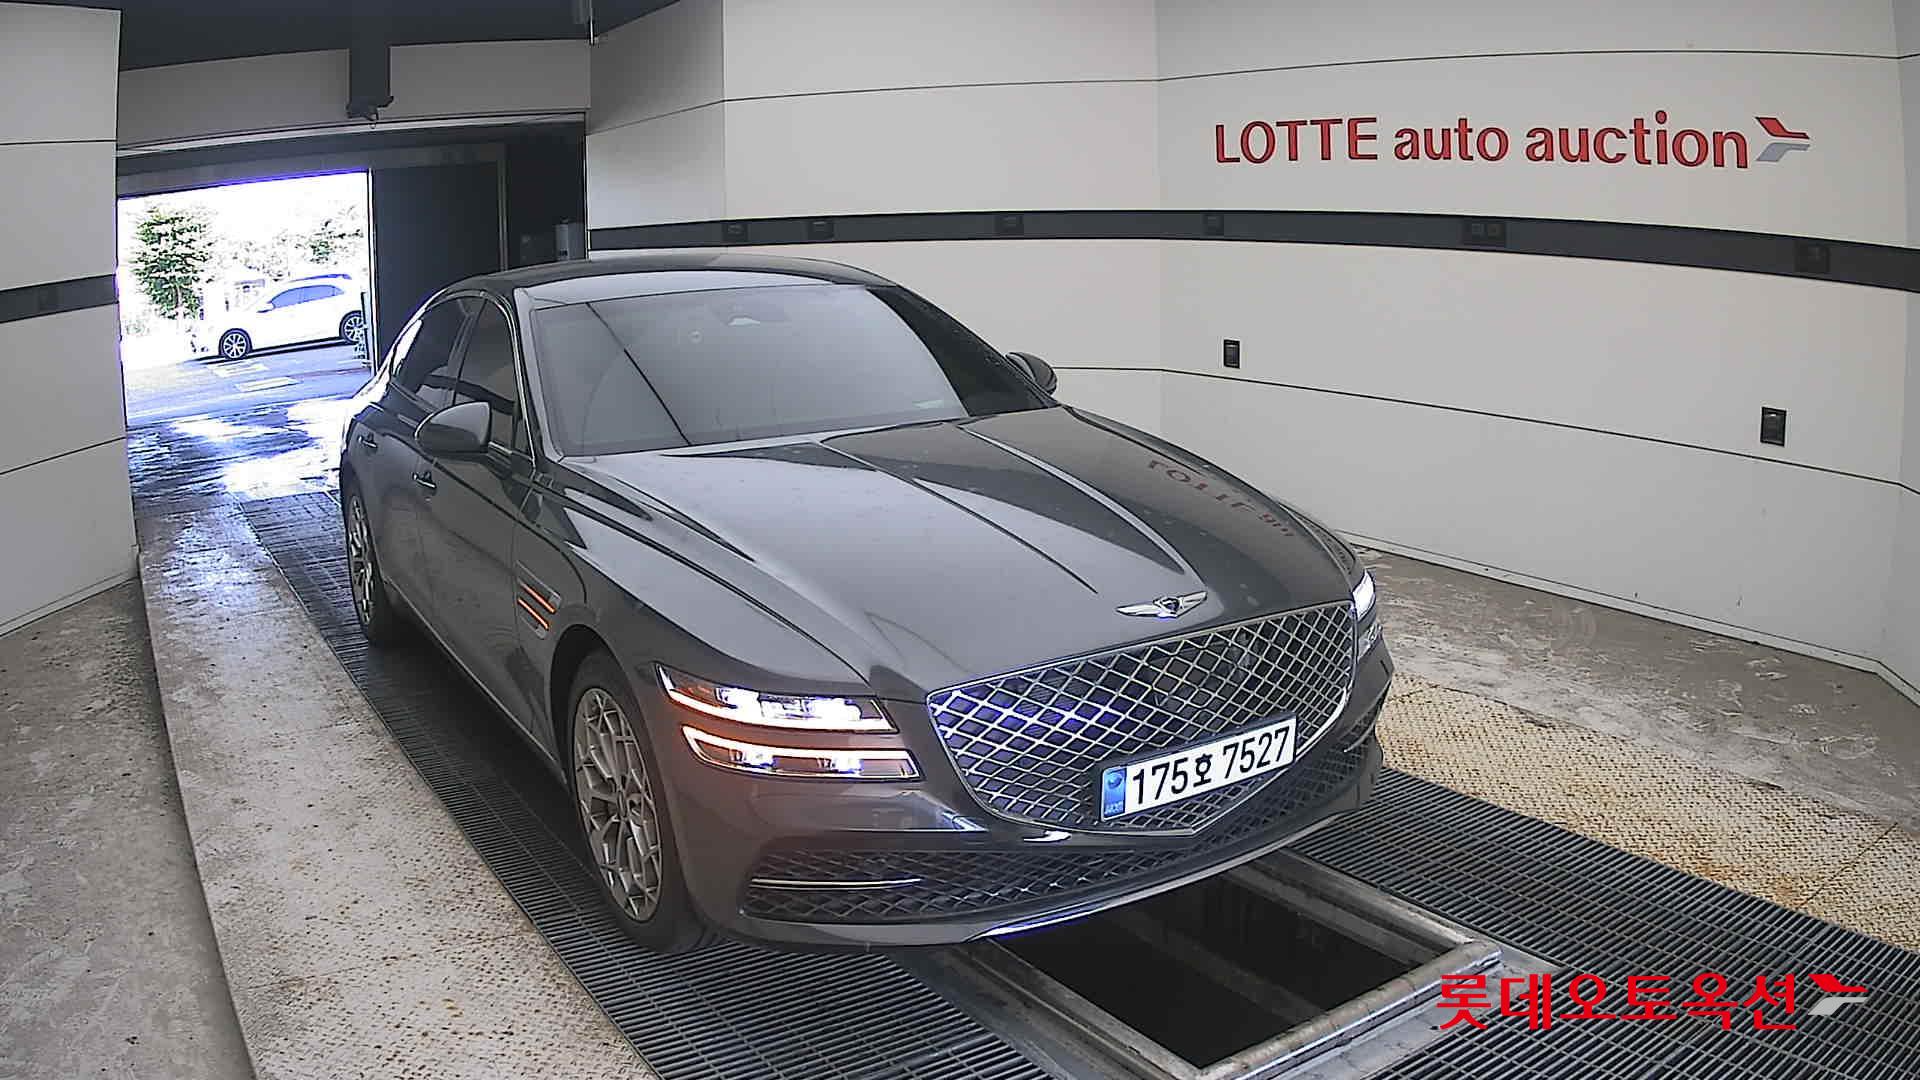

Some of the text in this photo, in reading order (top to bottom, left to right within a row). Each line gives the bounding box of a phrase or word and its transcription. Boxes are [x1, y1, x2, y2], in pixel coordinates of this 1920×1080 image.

[1215, 110, 1749, 169] LOTTE auto auction
[1132, 726, 1290, 805] 175호 7527
